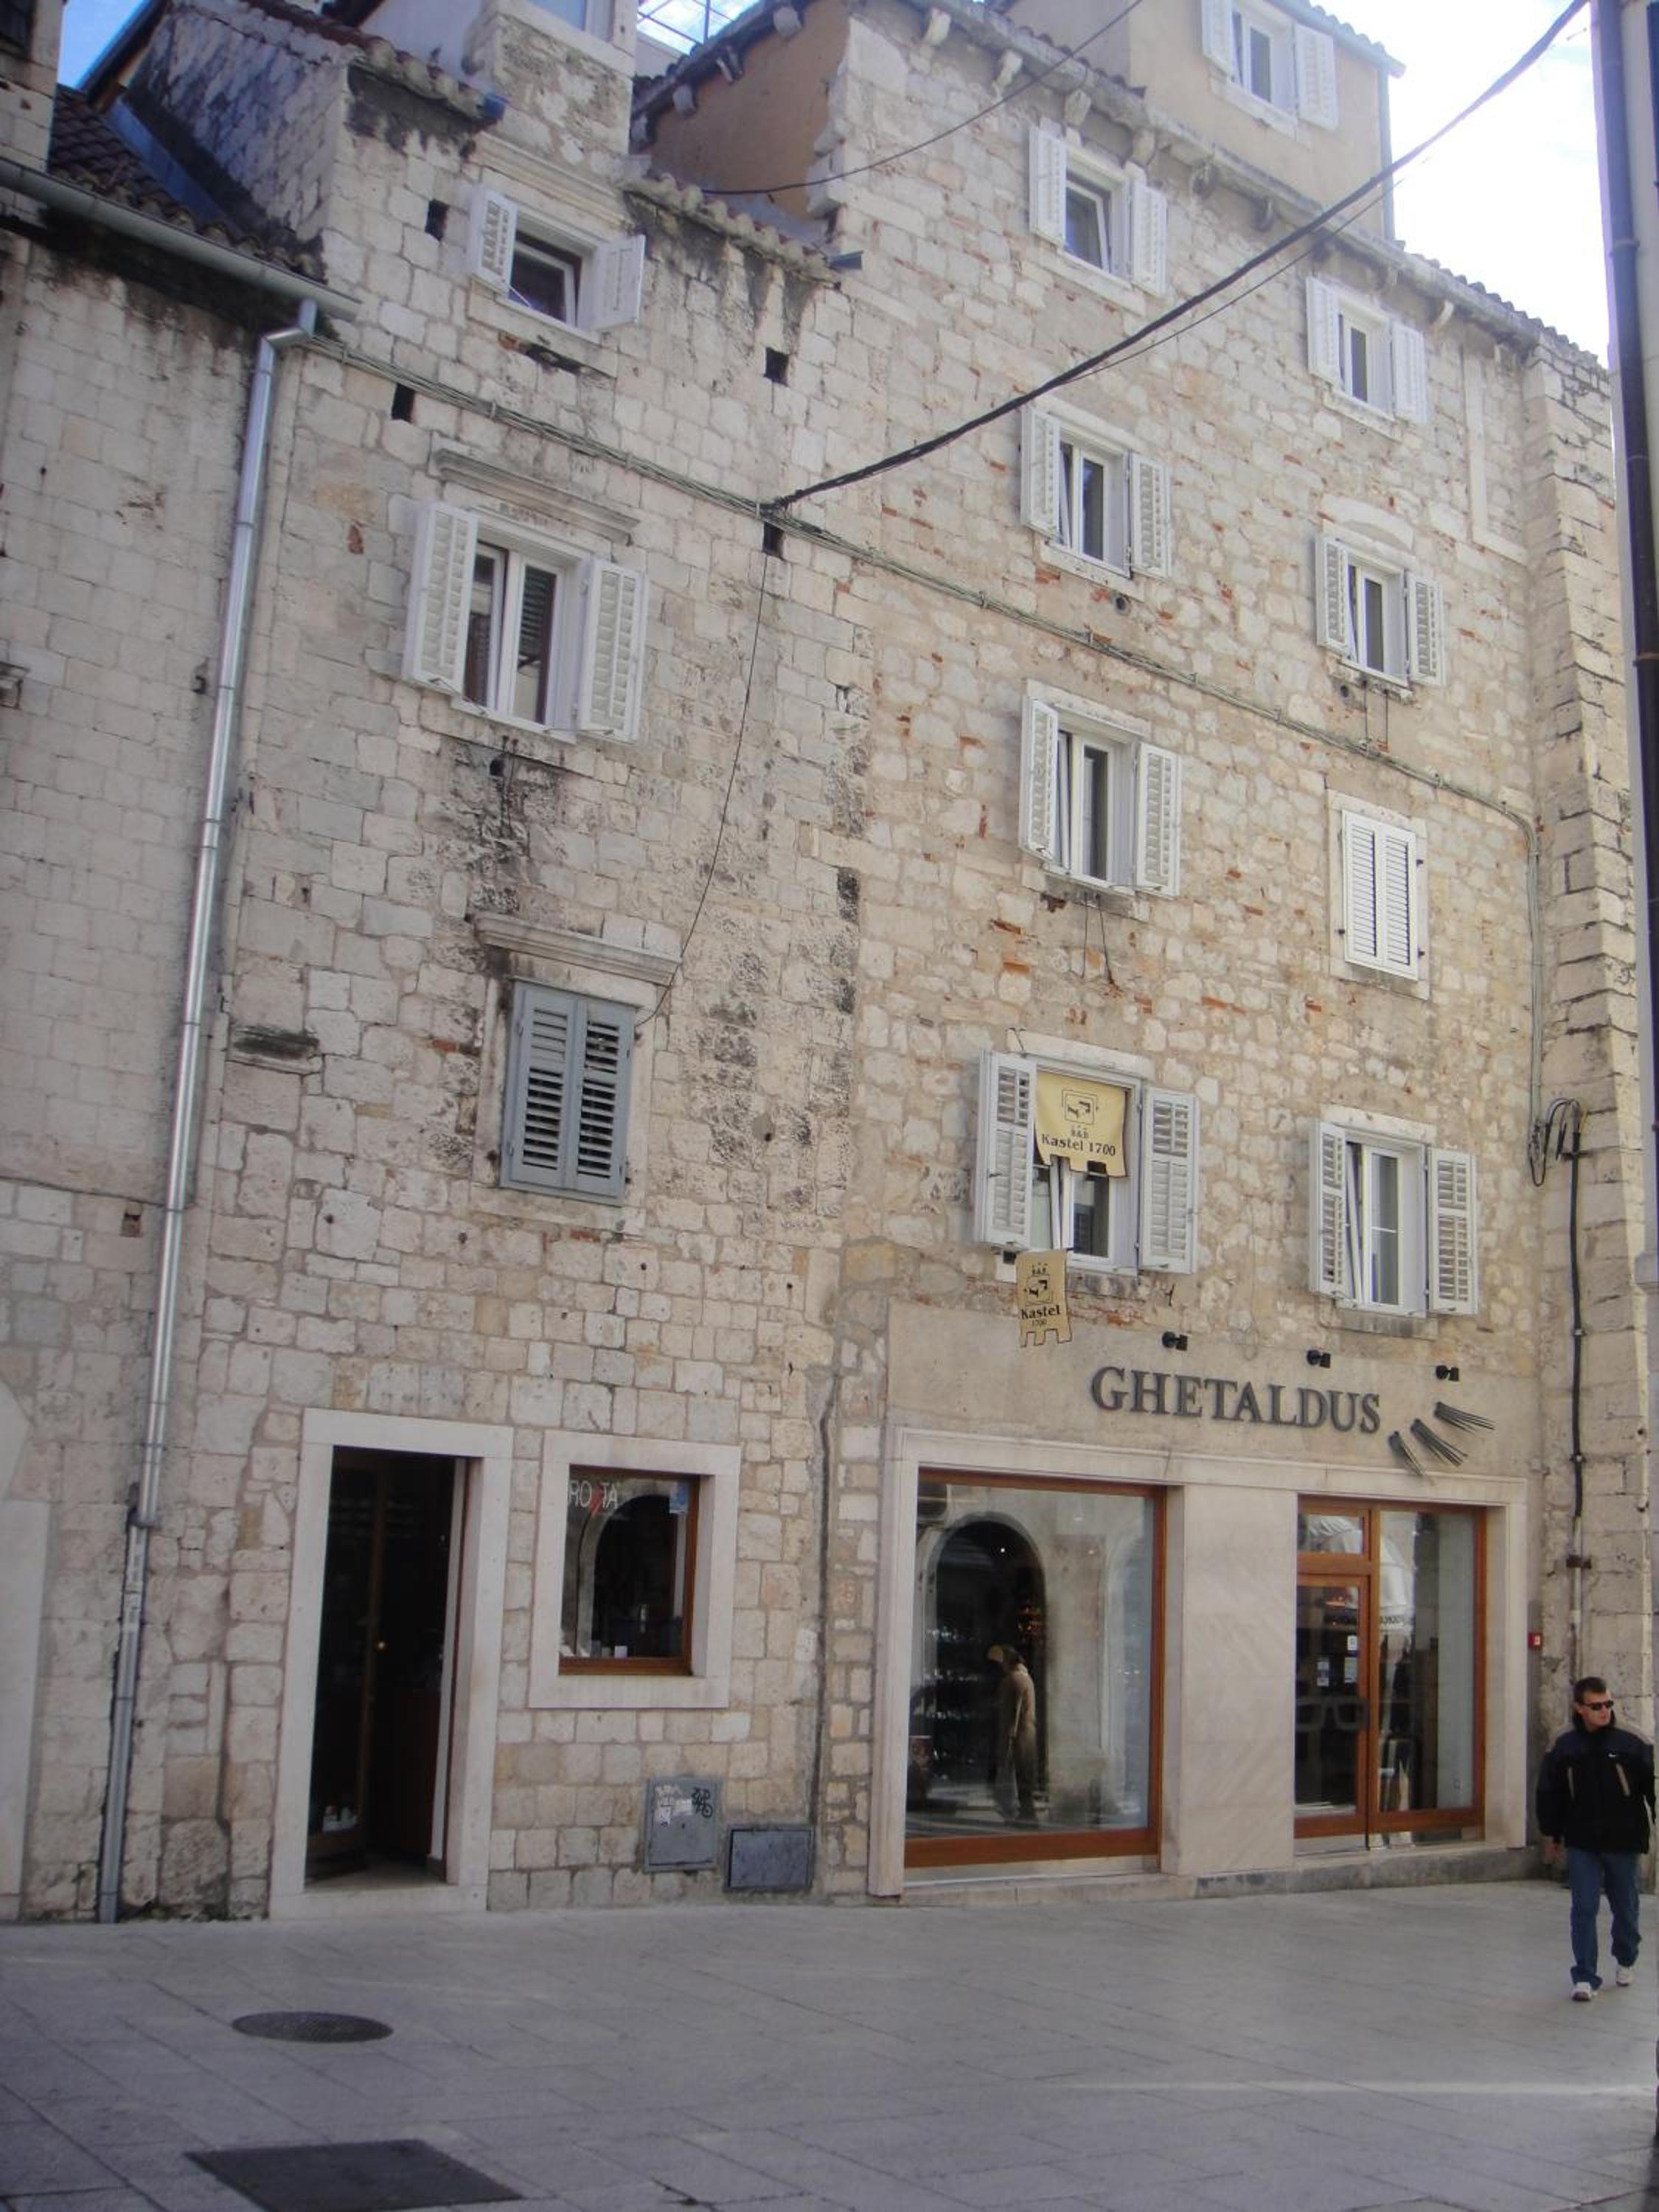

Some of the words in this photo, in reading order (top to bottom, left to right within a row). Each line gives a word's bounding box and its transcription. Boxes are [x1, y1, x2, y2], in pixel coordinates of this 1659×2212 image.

[1042, 1133, 1083, 1151] Kastel
[1089, 1141, 1116, 1156] 1700
[1021, 1304, 1060, 1319] Kastel
[1091, 1366, 1381, 1433] GHETALDUS
